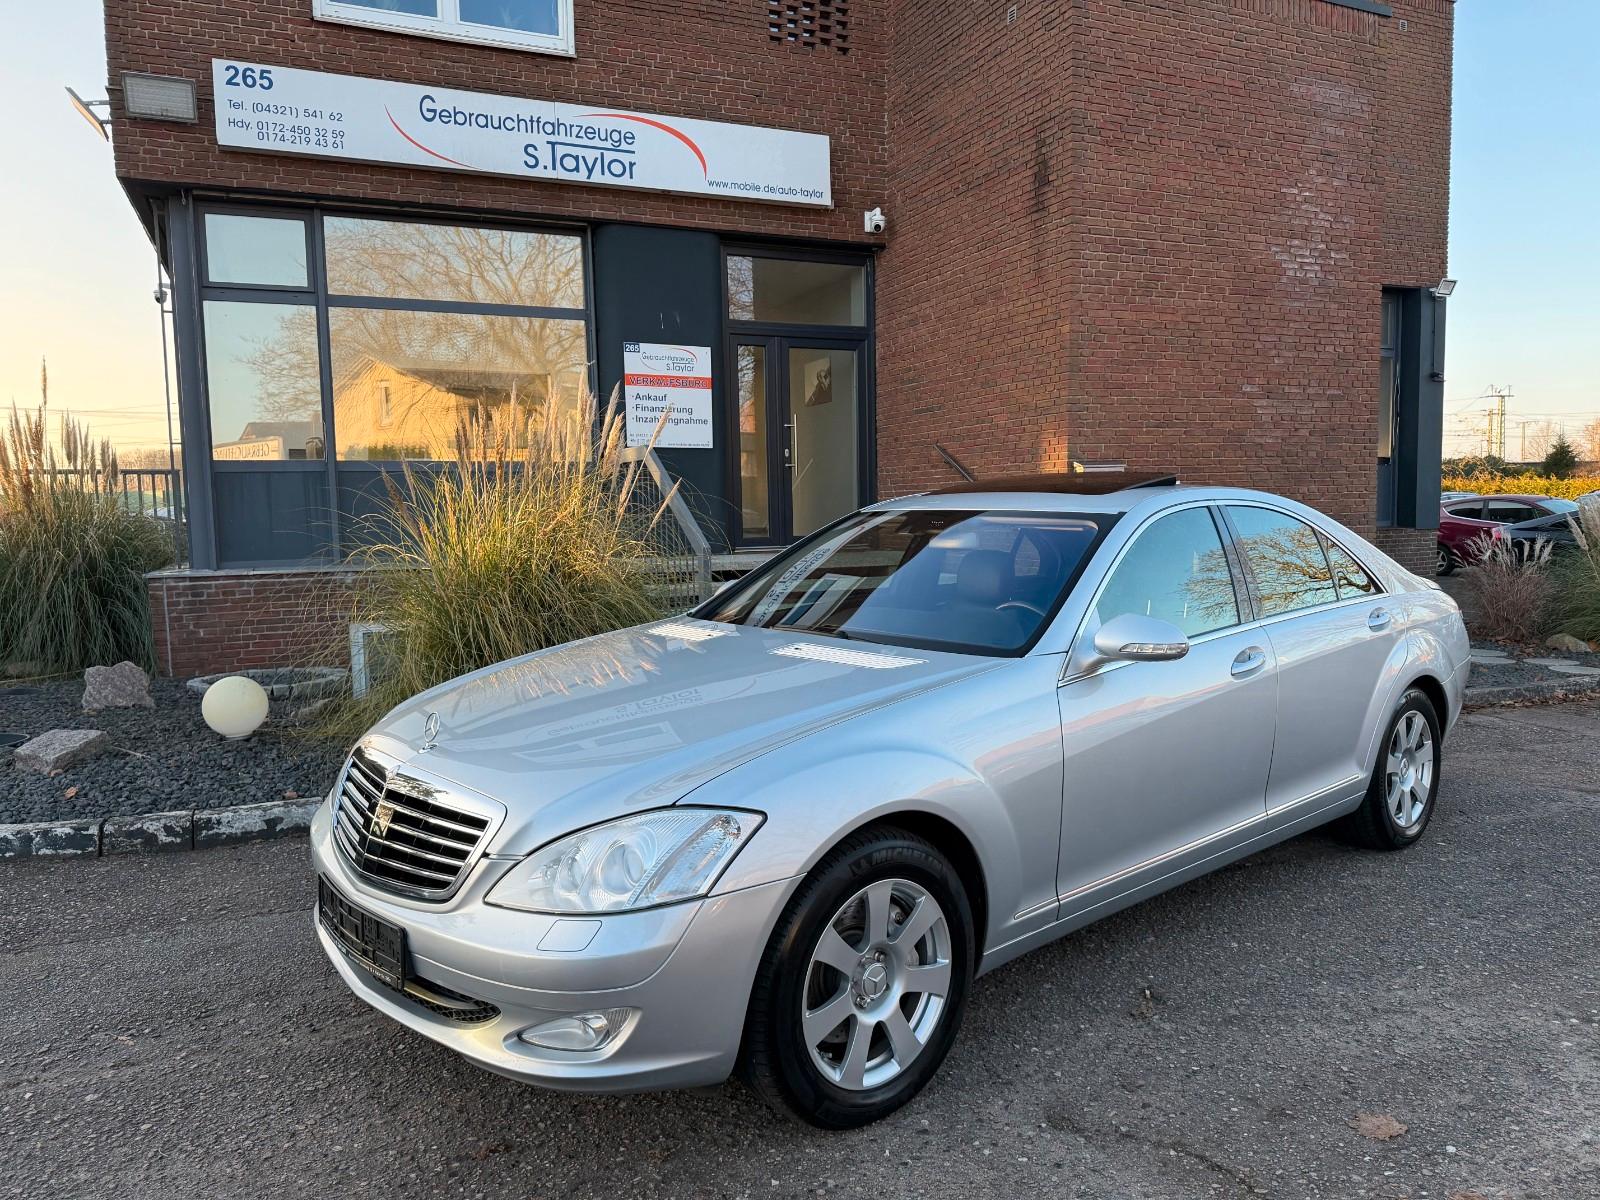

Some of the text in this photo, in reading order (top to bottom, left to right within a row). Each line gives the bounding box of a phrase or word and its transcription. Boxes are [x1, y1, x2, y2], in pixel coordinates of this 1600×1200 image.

[225, 65, 274, 90] 265
[227, 98, 343, 122] Tel. (04321) 541 62
[419, 94, 636, 149] Gebrauchtfahrzeuge
[227, 117, 345, 140] Hdy. 0172-450 32 59
[257, 132, 345, 150] 0174-219 43 61
[523, 140, 636, 181] S.Taylor
[708, 180, 824, 199] www.mobile.de/auto-taylor
[625, 344, 640, 352] 265
[635, 393, 667, 402] Ankauf
